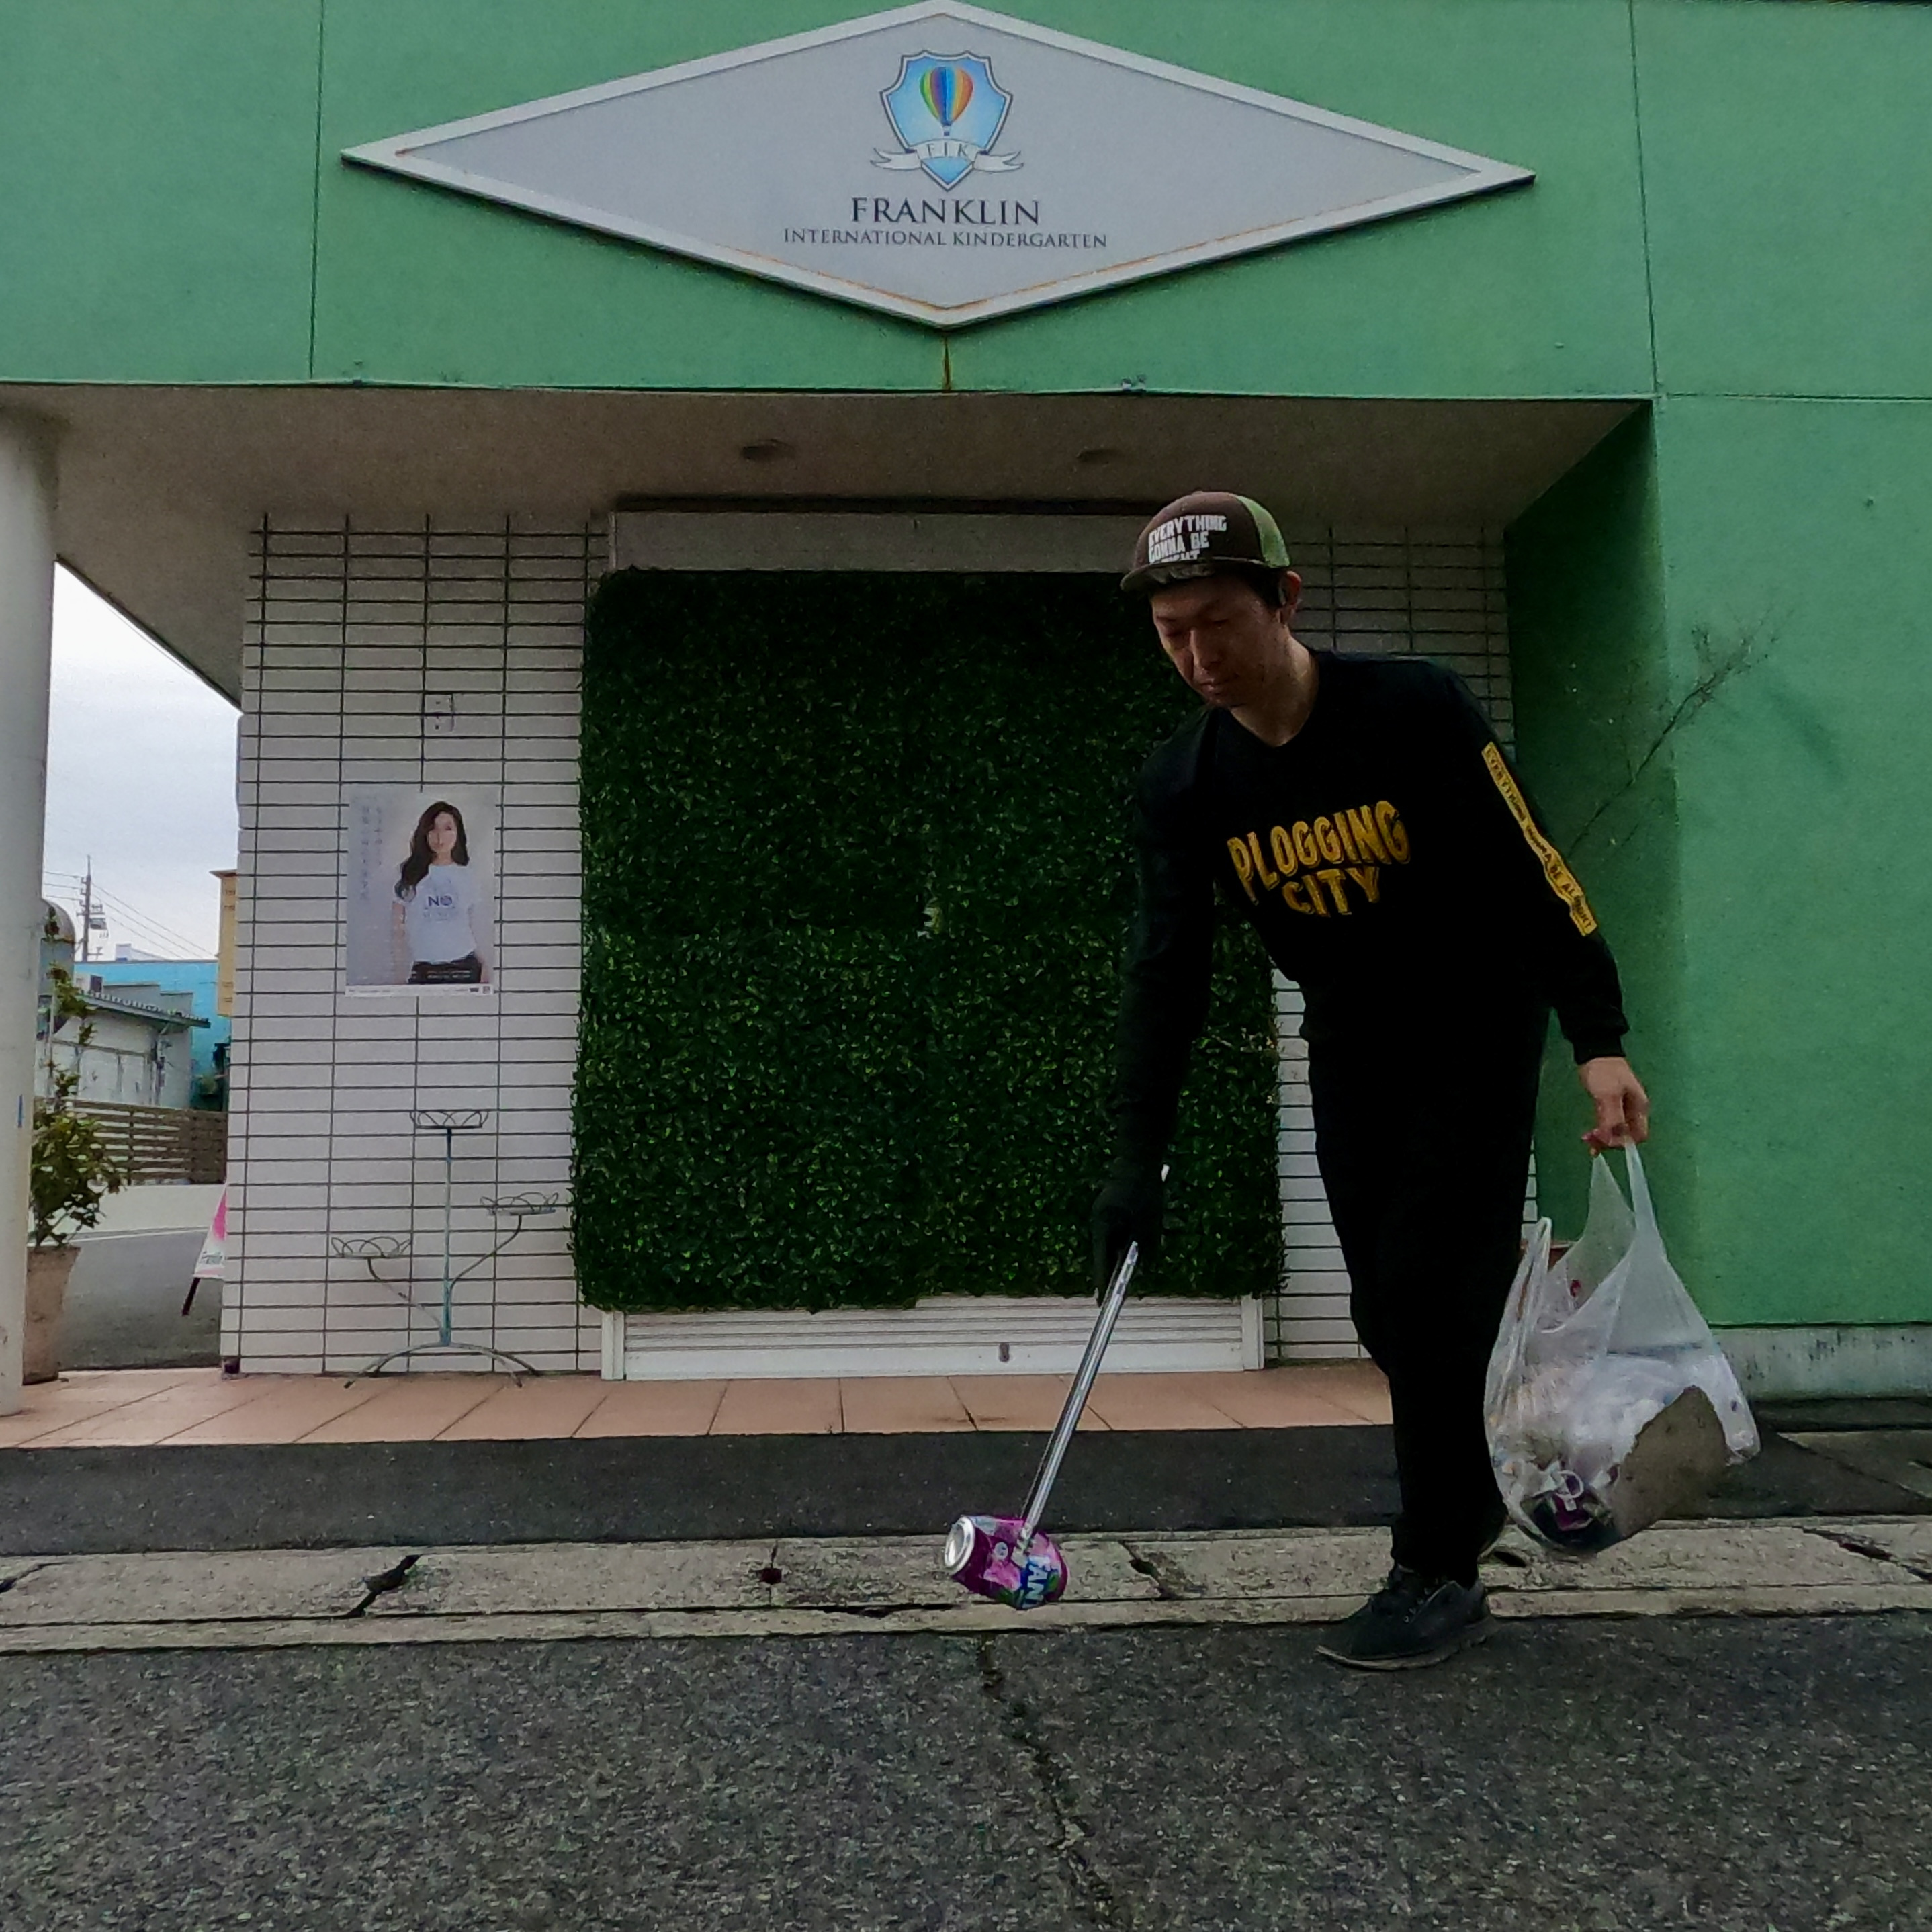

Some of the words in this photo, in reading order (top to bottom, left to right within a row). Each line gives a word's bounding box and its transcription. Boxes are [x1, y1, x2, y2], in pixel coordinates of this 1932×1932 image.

[851, 197, 1039, 225] FRANKLIN
[784, 228, 947, 246] INTERNATIONAL
[953, 231, 1107, 249] KINDERGARTEN
[1149, 514, 1227, 548] EVERYTHING
[1149, 535, 1186, 565] GONNA
[1190, 531, 1210, 550] BE
[1227, 800, 1411, 906] PLOGGING
[1281, 867, 1380, 918] CITY
